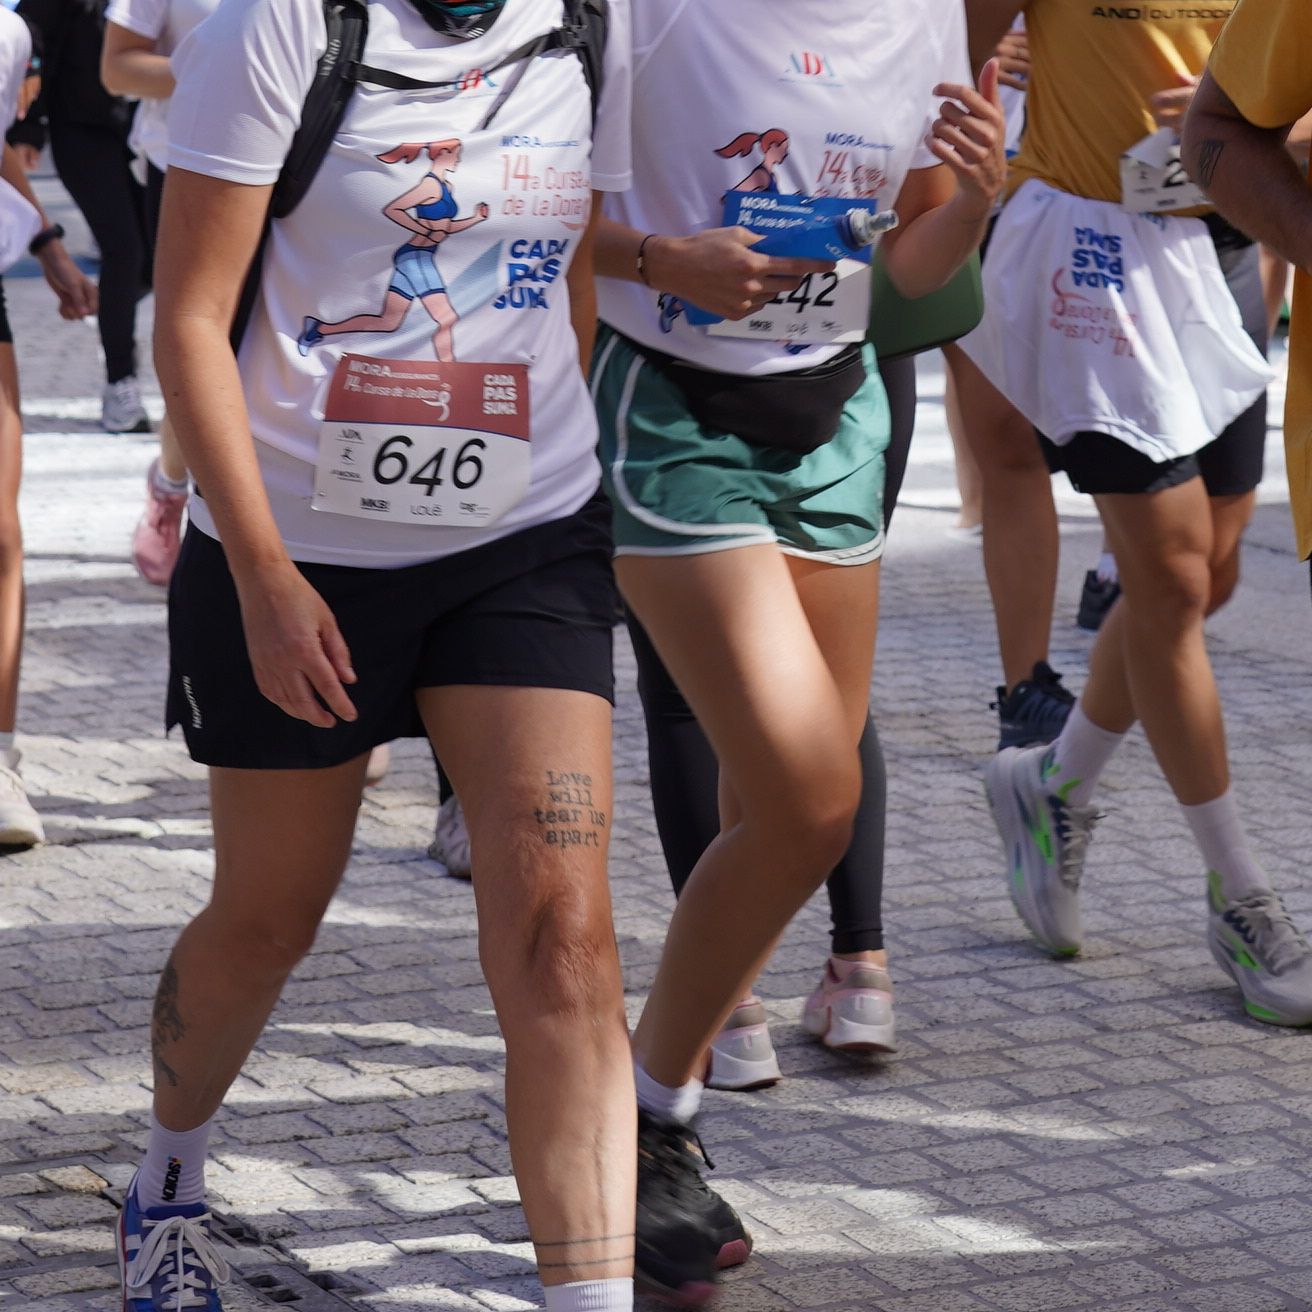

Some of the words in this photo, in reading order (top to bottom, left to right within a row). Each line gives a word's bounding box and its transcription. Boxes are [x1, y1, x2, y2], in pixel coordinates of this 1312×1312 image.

[1071, 248, 1125, 277] PAS
[768, 271, 839, 314] 42
[482, 387, 518, 402] PAS
[372, 434, 487, 497] 646
[545, 770, 593, 786] Love
[549, 788, 594, 807] will
[533, 806, 582, 825] tear
[590, 810, 606, 828] us
[545, 829, 600, 849] apart
